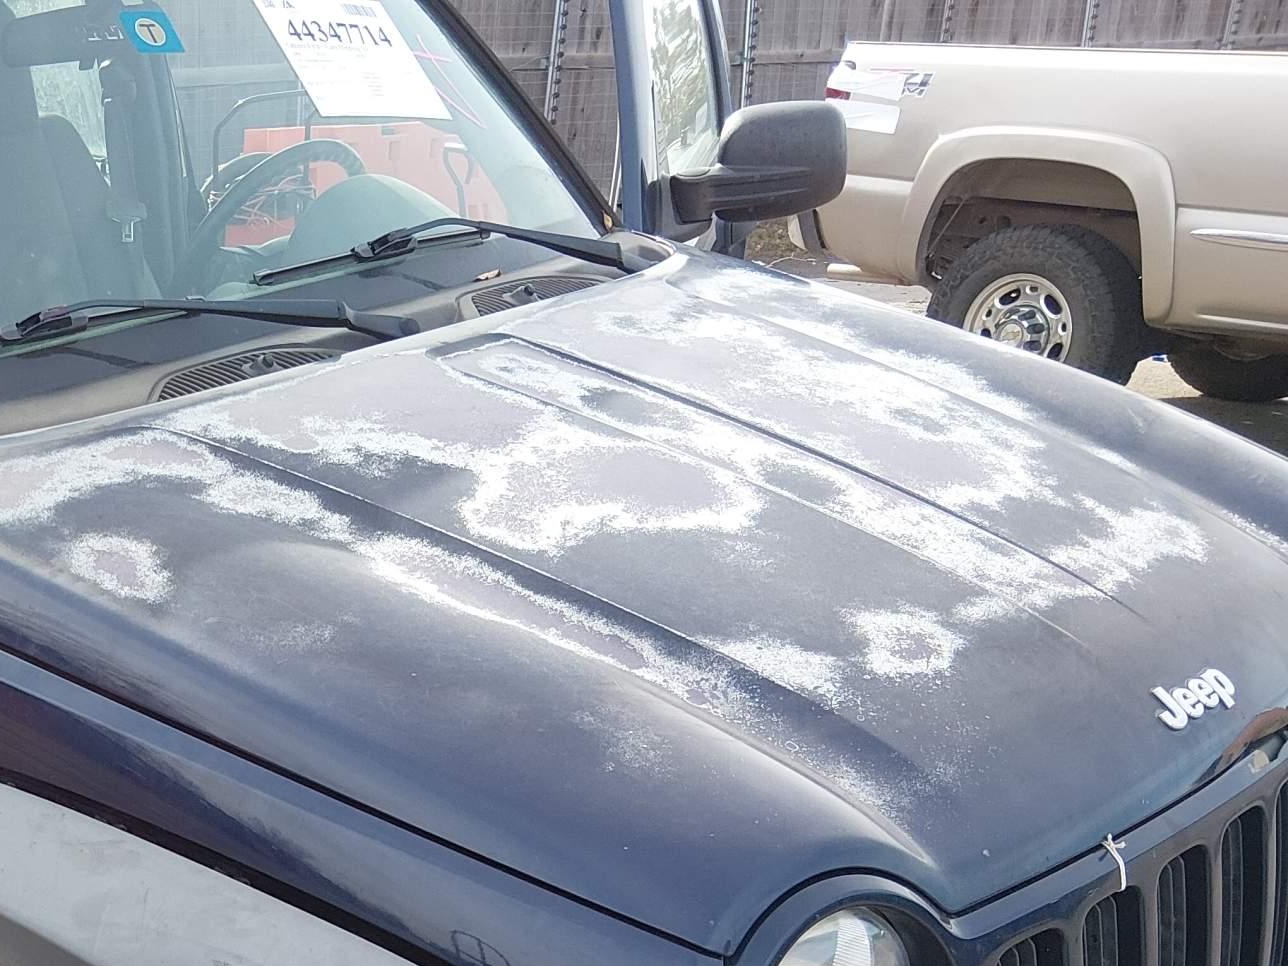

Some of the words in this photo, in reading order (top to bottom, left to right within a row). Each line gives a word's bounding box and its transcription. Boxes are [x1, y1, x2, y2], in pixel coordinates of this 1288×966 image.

[139, 23, 158, 44] T
[288, 19, 393, 47] 44347714
[1150, 667, 1236, 731] Jeep
